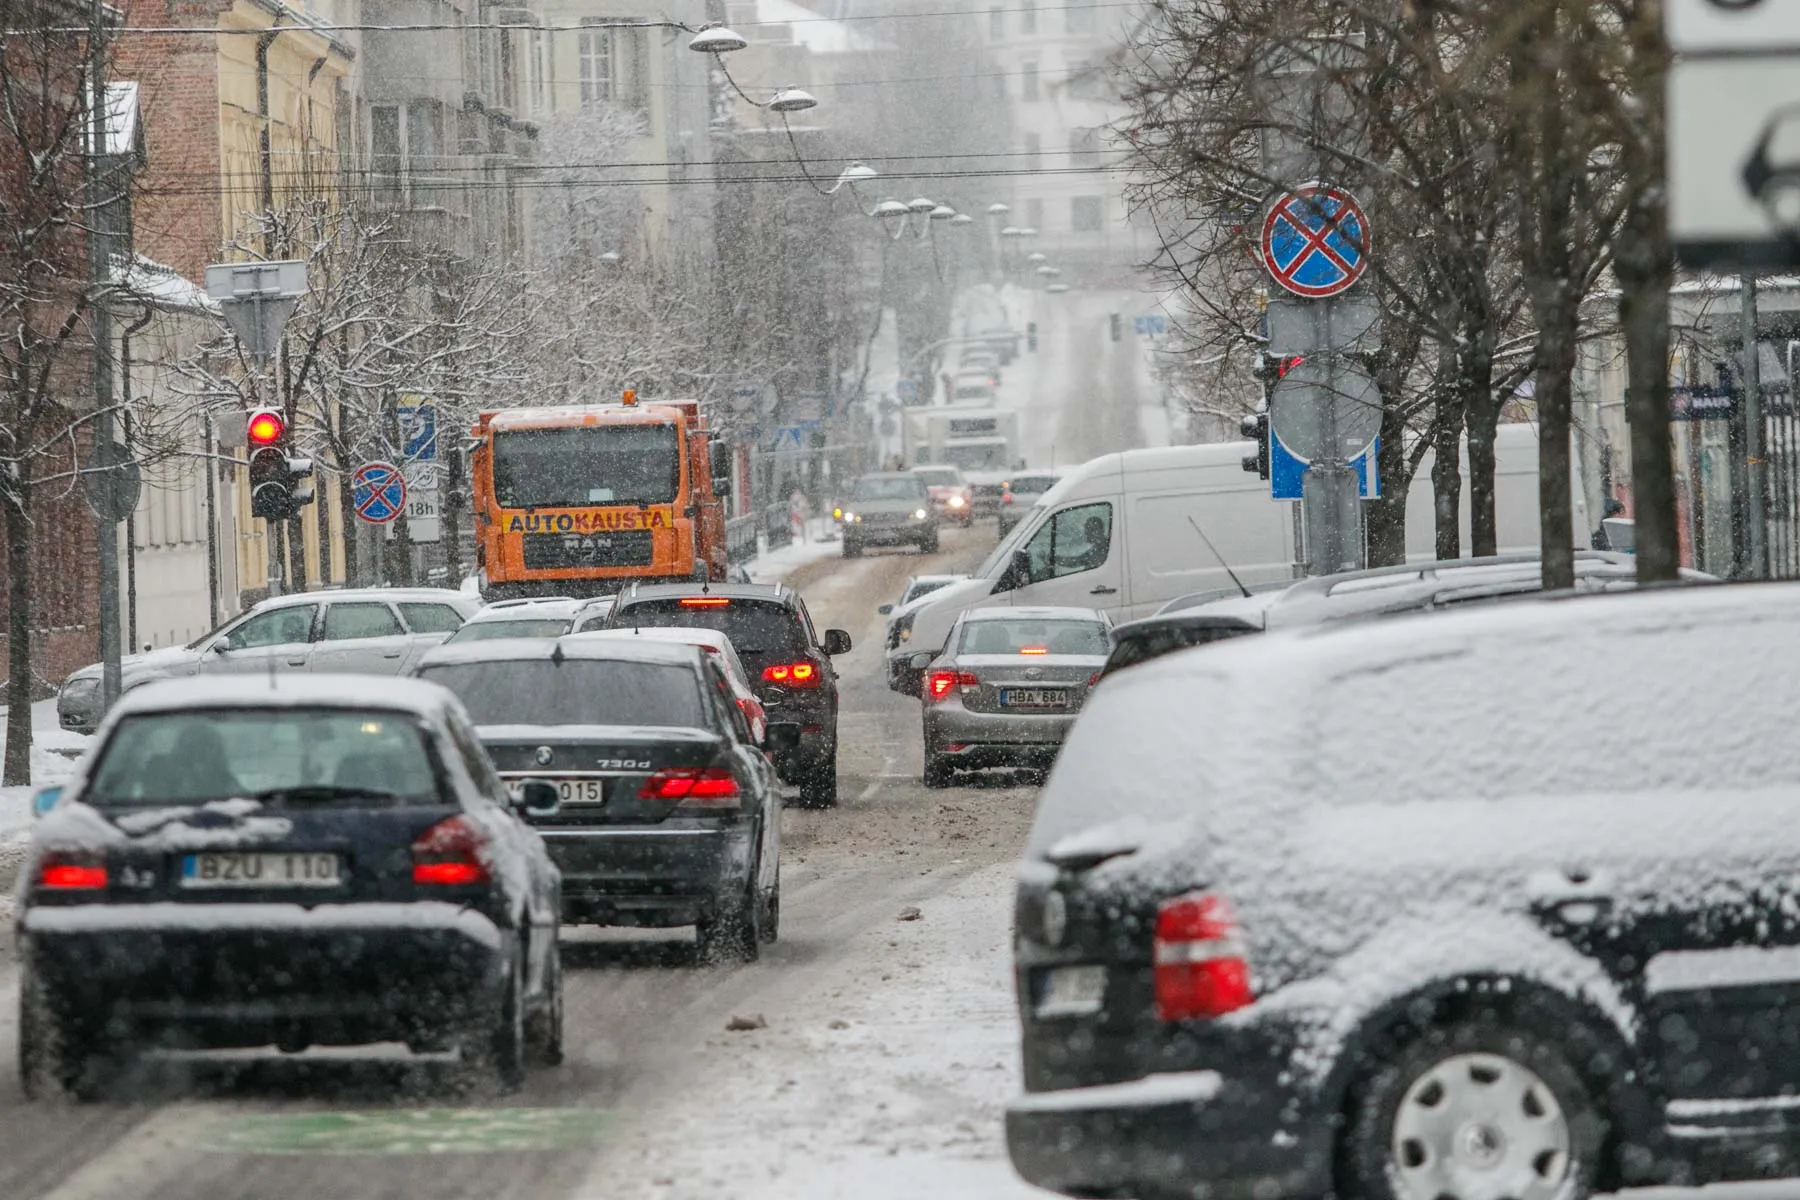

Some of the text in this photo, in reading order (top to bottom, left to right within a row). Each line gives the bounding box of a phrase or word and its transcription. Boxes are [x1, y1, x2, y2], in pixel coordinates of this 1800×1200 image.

[409, 502, 434, 516] 18h
[509, 510, 666, 532] AUTOKAUSTA
[564, 538, 612, 549] MAN
[1009, 691, 1065, 703] HBA 684
[597, 759, 651, 769] 730d
[560, 782, 599, 800] 015
[202, 854, 332, 879] BZU 110
